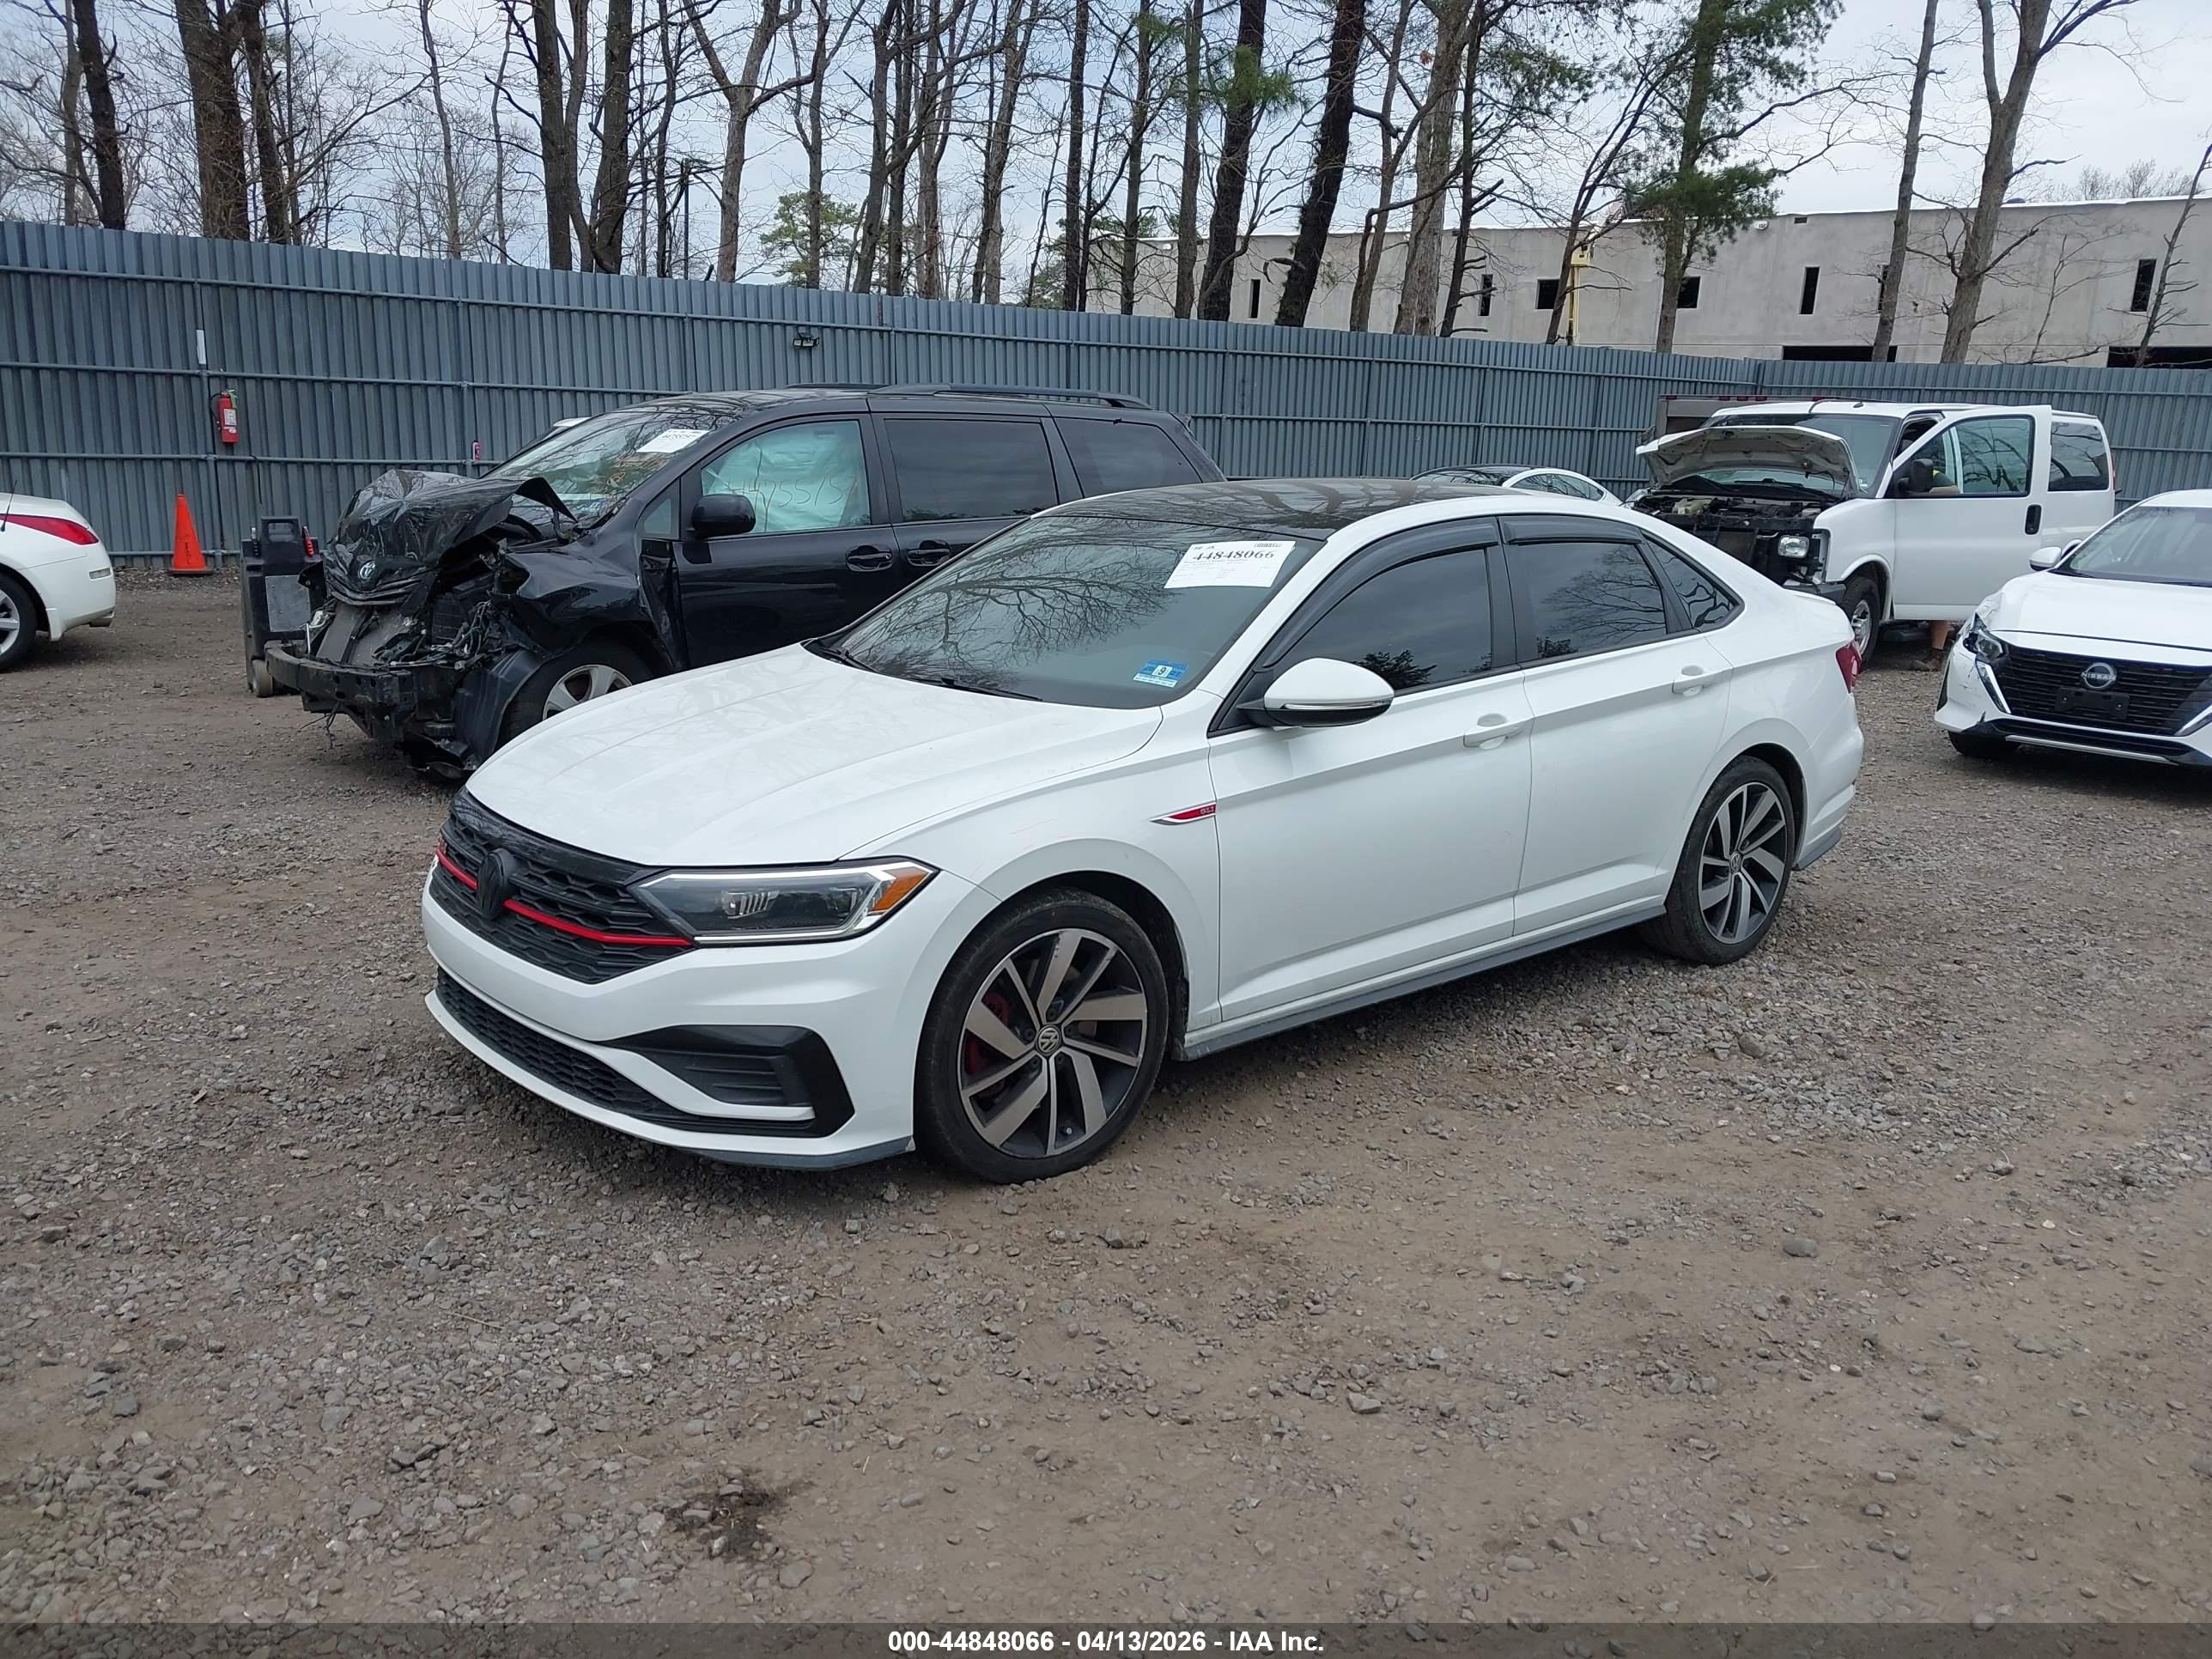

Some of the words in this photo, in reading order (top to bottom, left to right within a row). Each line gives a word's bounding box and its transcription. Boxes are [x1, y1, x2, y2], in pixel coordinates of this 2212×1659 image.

[1193, 550, 1277, 561] 44848066
[1158, 666, 1167, 676] 9
[2081, 672, 2117, 682] NISSAN
[1200, 806, 1214, 815] GLI
